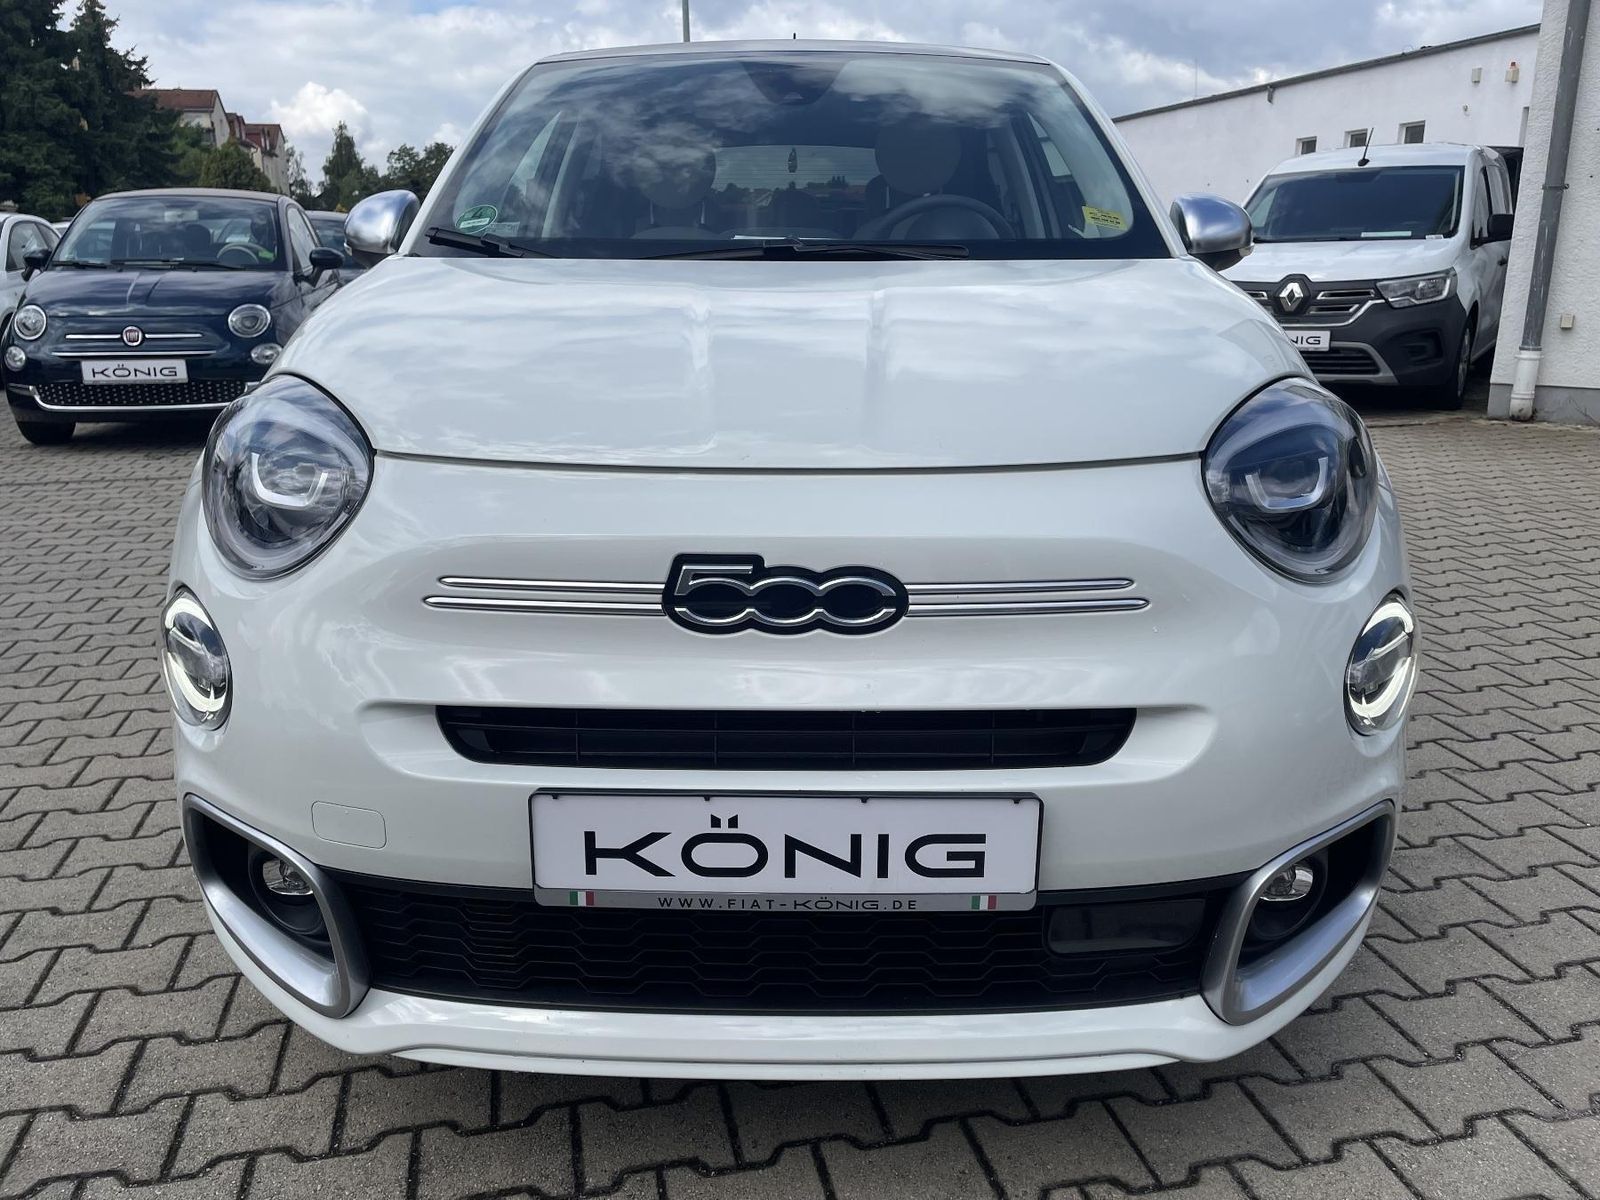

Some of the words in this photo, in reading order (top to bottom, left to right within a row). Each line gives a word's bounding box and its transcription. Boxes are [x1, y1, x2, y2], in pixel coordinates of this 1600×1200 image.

[92, 364, 177, 378] KÖNIG
[672, 562, 898, 628] 500
[584, 814, 986, 878] KÖNIG
[658, 896, 917, 910] WWW.FIAT-KÖNIG.DE
